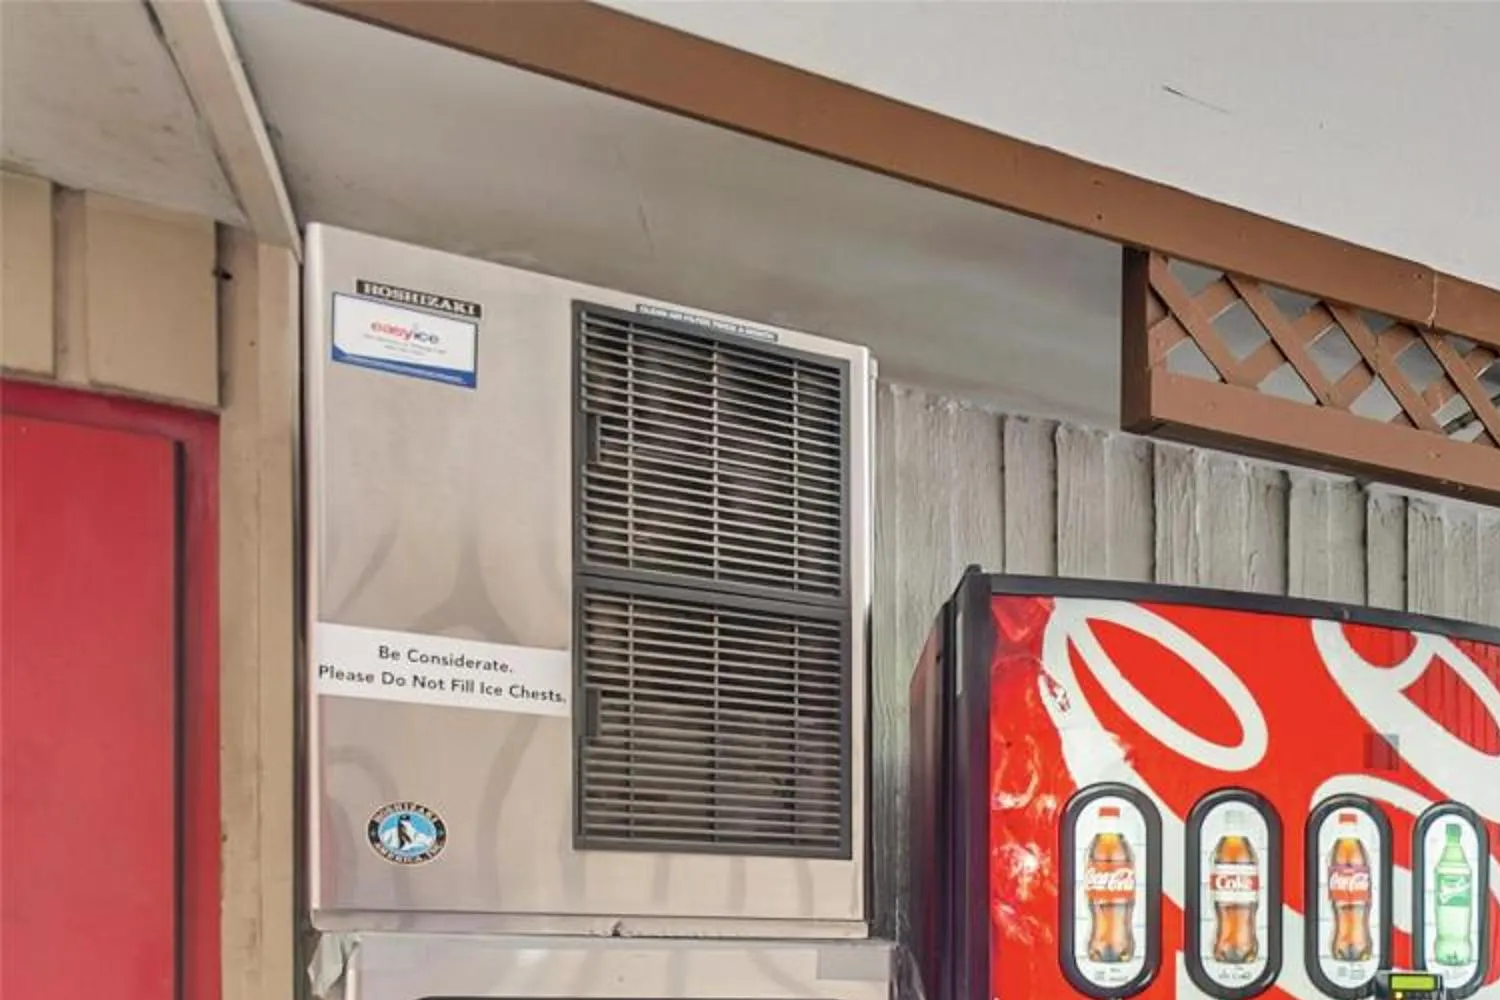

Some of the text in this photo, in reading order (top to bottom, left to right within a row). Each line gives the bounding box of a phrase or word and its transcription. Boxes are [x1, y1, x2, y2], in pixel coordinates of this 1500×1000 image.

[363, 282, 477, 315] HOSHIZAKI
[379, 645, 513, 674] Be Considerate.
[318, 664, 567, 704] Please Do Not Fill Ice Chests.
[1216, 874, 1254, 890] Coke
